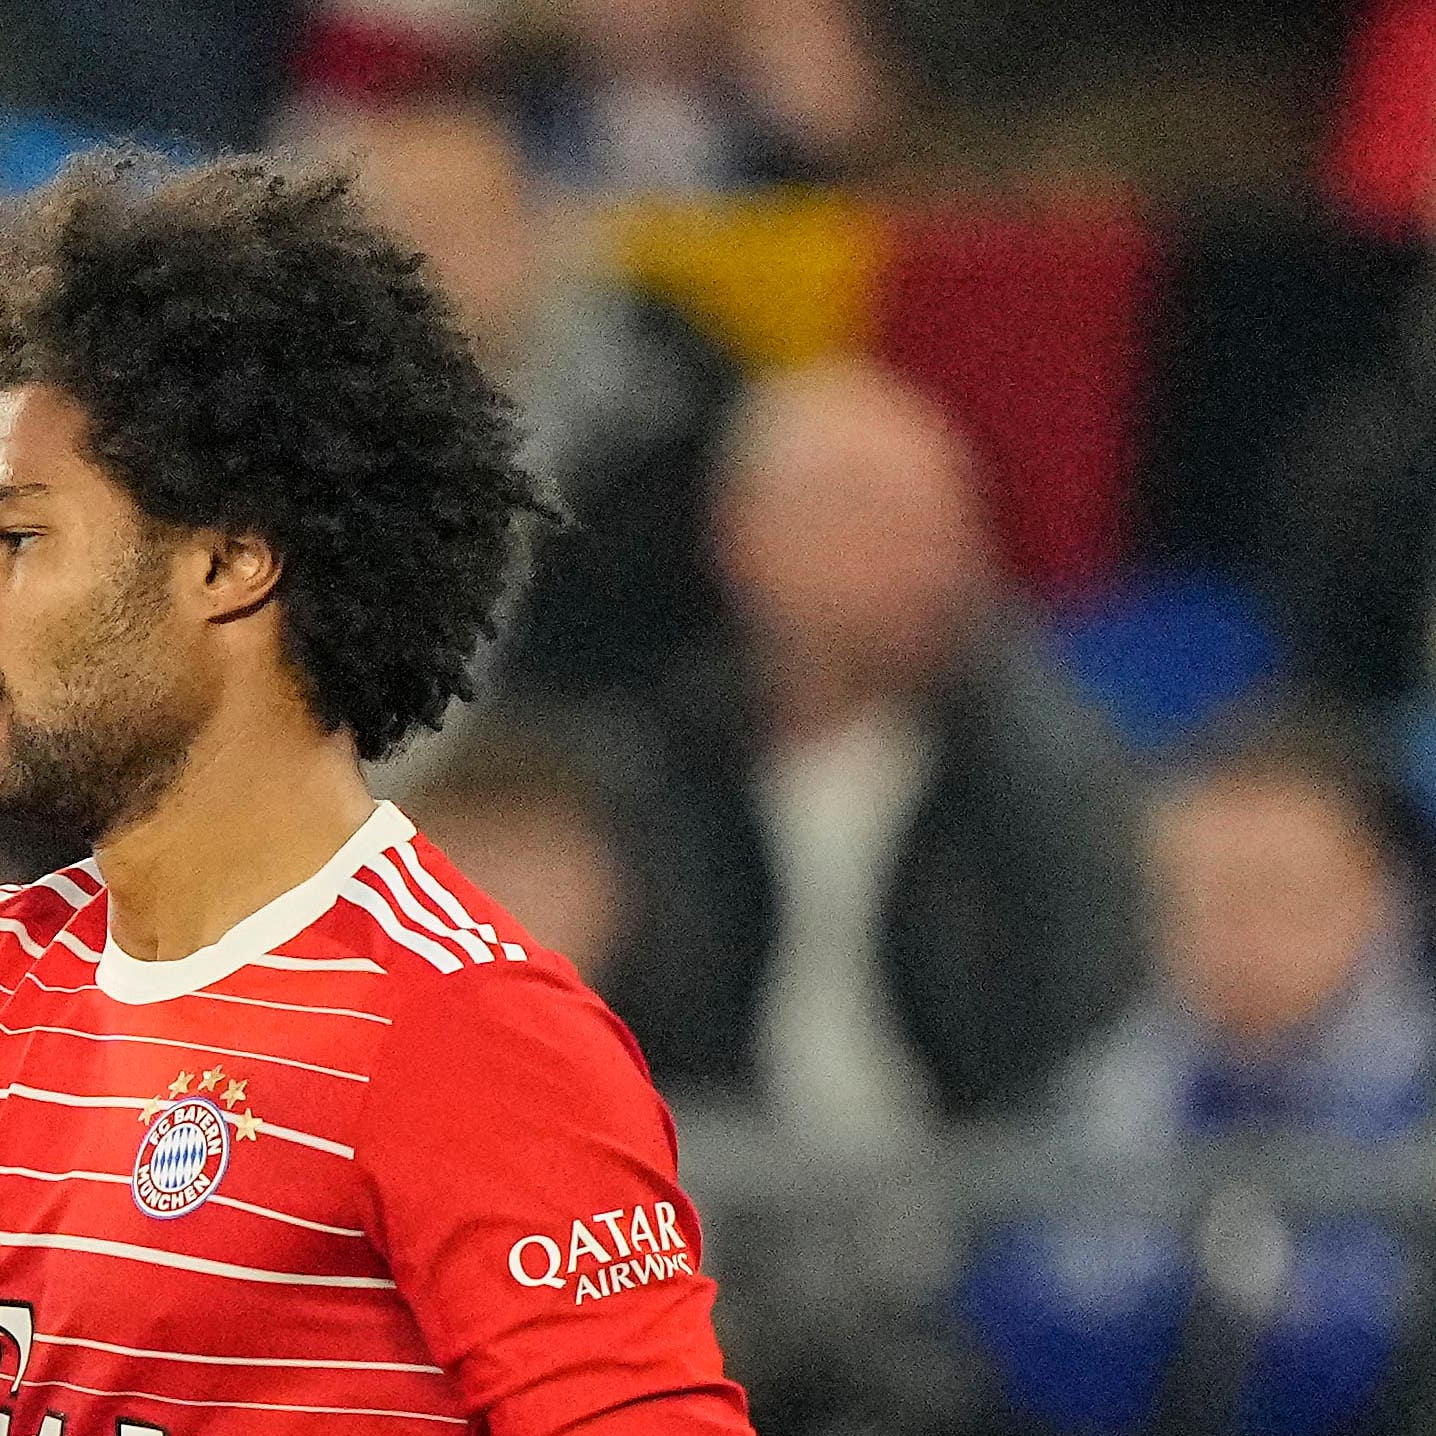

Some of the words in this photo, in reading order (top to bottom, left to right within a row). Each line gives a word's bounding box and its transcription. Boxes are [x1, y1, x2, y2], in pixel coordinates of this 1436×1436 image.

[149, 1118, 171, 1146] FC
[174, 1106, 222, 1156] BAYERN
[507, 1201, 686, 1289] QATAR
